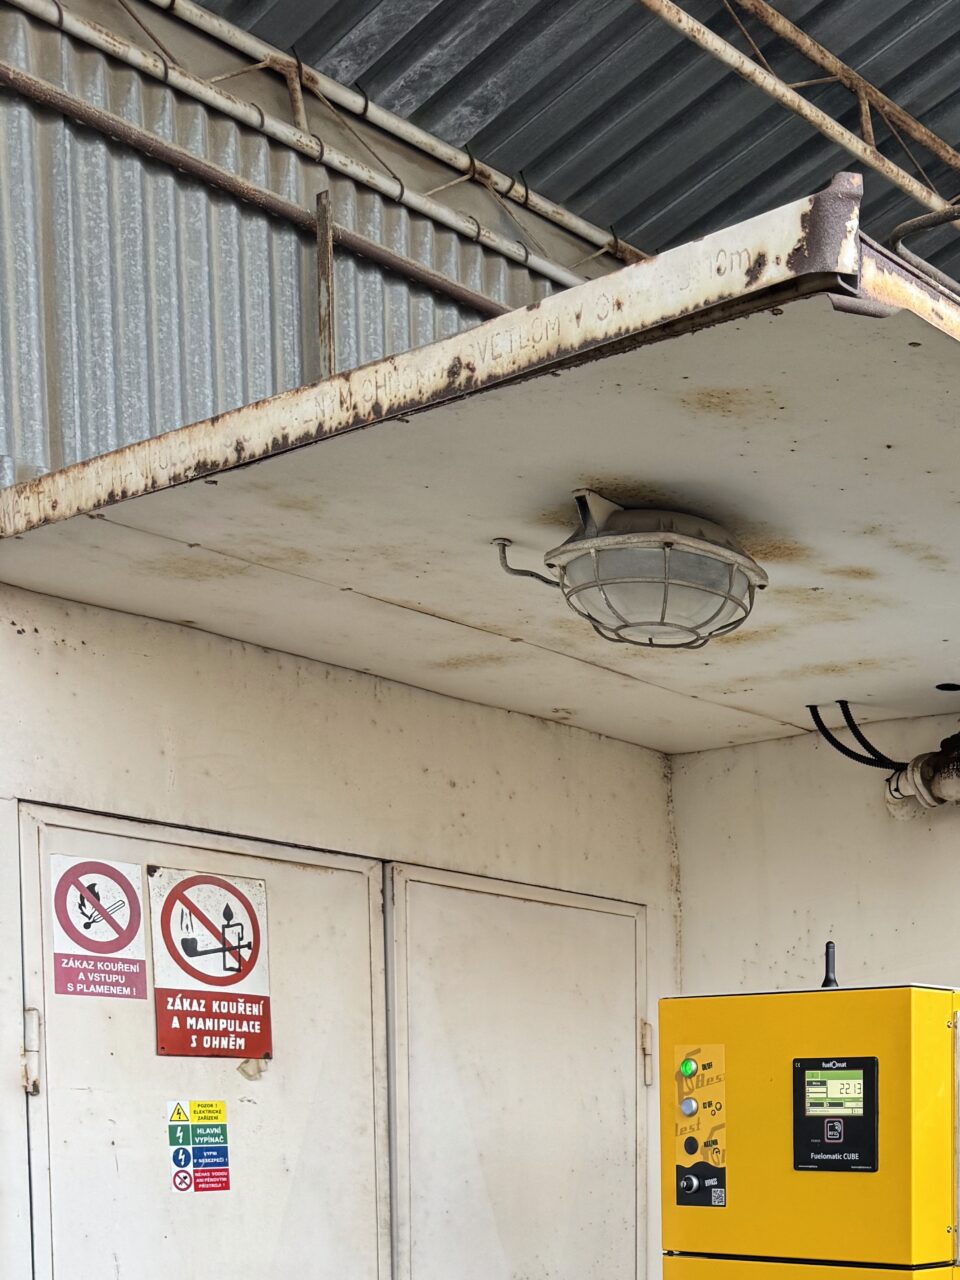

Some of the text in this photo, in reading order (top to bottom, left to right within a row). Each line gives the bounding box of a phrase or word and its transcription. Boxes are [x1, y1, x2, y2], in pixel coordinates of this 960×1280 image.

[61, 958, 140, 973] ZÁKAZ KOUŘENÍ
[78, 973, 126, 983] A VSTUPU
[67, 983, 74, 991] S
[76, 983, 131, 995] PLAMENEM
[166, 994, 264, 1016] ZÁKAZ KOUŘENÍ
[171, 1016, 261, 1033] A MANIPULACE
[190, 1034, 245, 1050] S OHNĚM
[196, 1126, 221, 1135] HLAVNÍ
[810, 1152, 860, 1160] Fuelomatic CUBE
